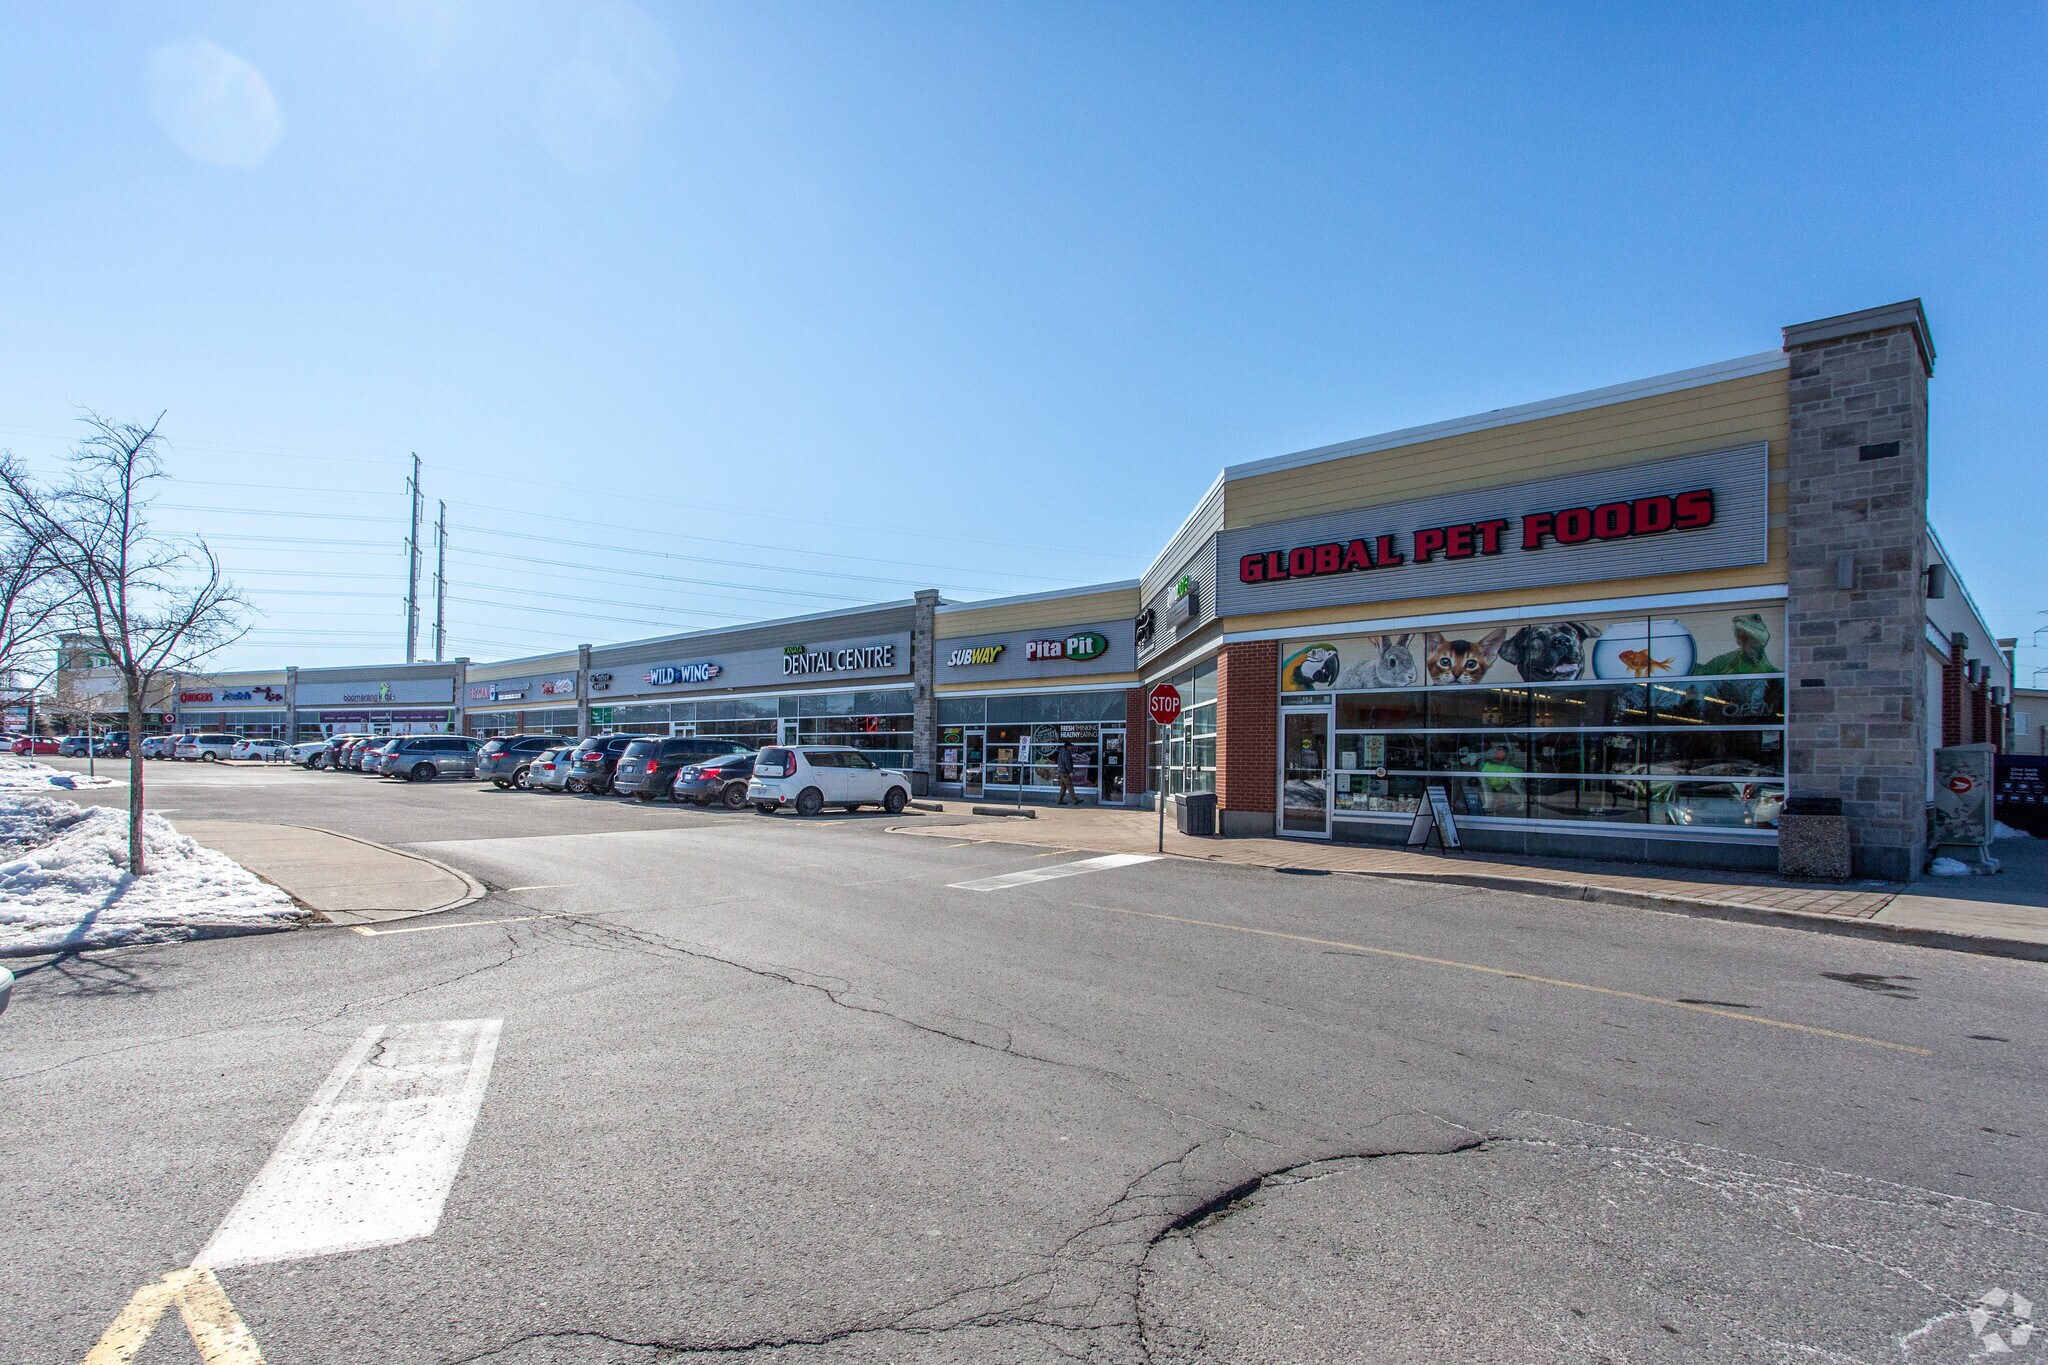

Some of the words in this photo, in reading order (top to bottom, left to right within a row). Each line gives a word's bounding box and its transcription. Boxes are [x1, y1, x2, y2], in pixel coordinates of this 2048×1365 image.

[1239, 534, 1404, 584] GLOBAL
[1412, 518, 1508, 563] PET
[1520, 488, 1715, 551] FOODS
[783, 645, 803, 655] KANATA
[783, 652, 834, 675] DENTAL
[836, 644, 893, 671] CENTRE
[947, 645, 1004, 667] SUBWAY
[1025, 640, 1063, 661] Pita
[1066, 636, 1094, 656] Pit
[649, 666, 675, 686] WILD
[680, 663, 710, 683] WING
[1151, 696, 1180, 712] STOP
[1722, 703, 1774, 716] OPEN
[1075, 724, 1098, 732] THINKING
